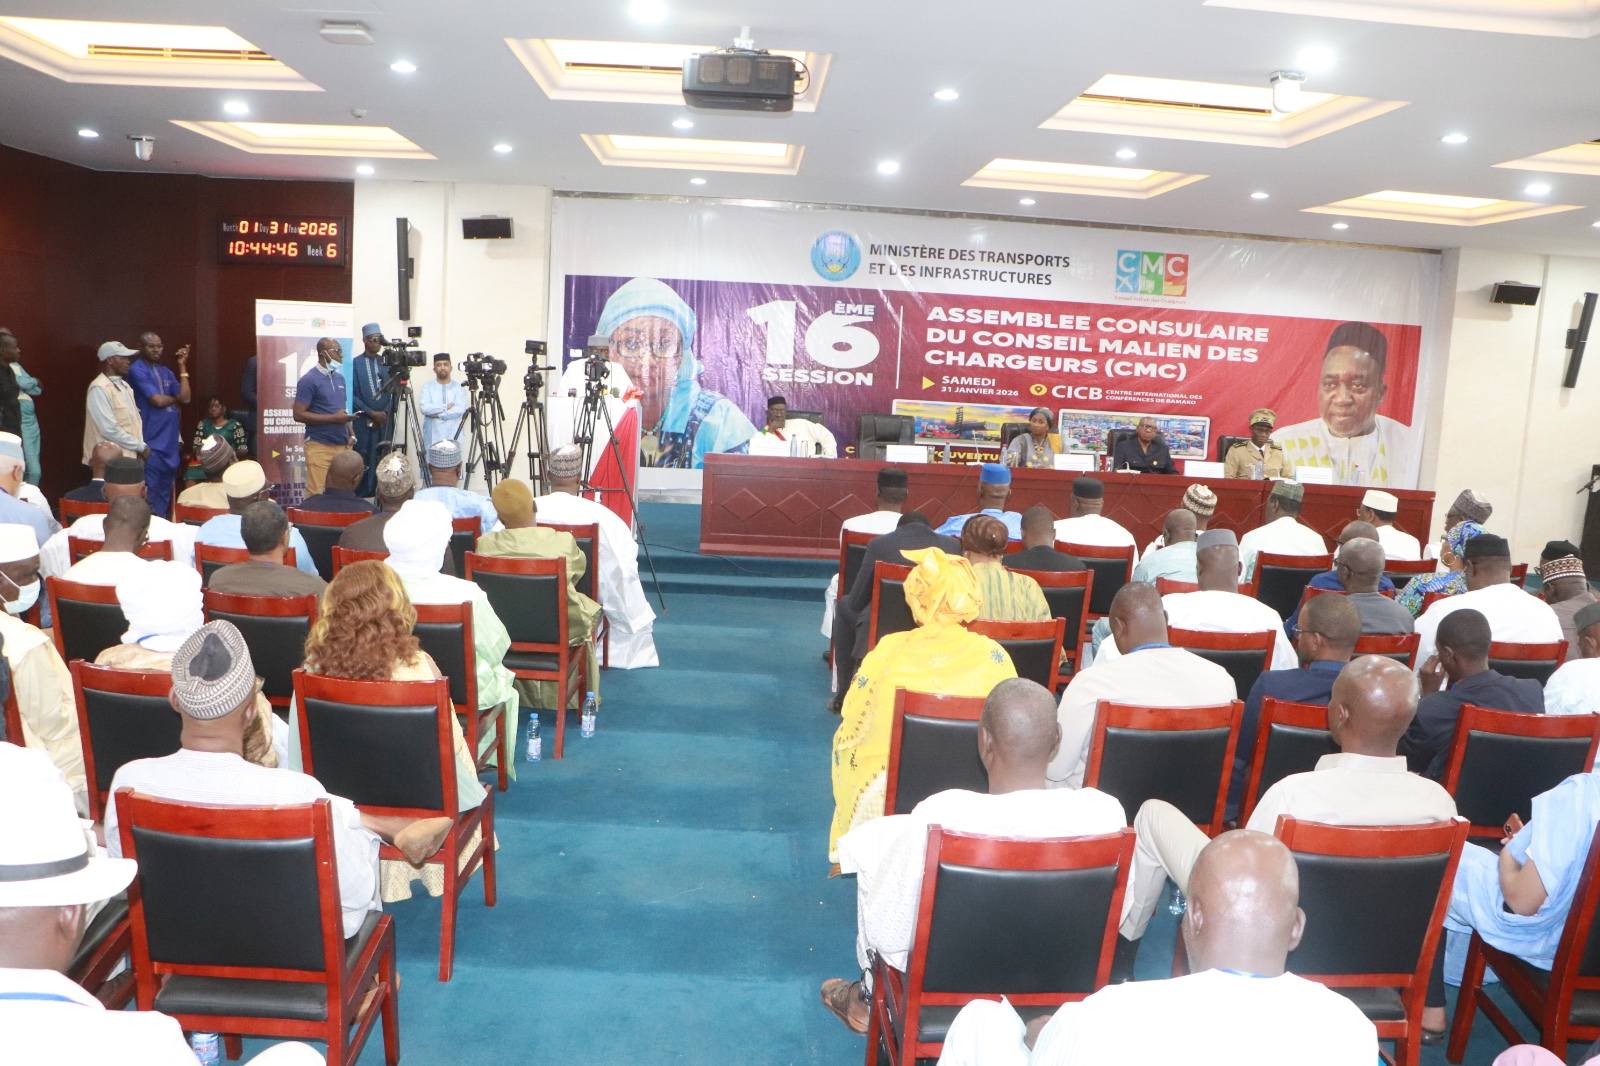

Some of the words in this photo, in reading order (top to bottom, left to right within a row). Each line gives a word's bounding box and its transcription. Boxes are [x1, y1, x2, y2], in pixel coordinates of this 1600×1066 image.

[298, 222, 338, 236] 2026
[229, 241, 298, 257] 10:44:46
[307, 245, 324, 257] Week
[326, 243, 337, 258] 6
[869, 243, 945, 260] MINISTÈRE
[948, 247, 976, 262] DES
[979, 250, 1071, 268] TRANSPORTS
[1118, 252, 1186, 277] CMC
[869, 262, 885, 275] ET
[889, 264, 916, 278] DES
[919, 266, 1053, 286] INFRASTRUCTURES
[834, 300, 875, 316] ÈME
[926, 306, 1091, 331] ASSEMBLEE
[1096, 317, 1270, 343] CONSULAIRE
[746, 300, 881, 369] 16
[926, 327, 966, 344] DU
[972, 330, 1093, 353] CONSEIL
[1098, 338, 1201, 360] MALIEN
[1207, 345, 1259, 363] DES
[924, 349, 1098, 375] CHARGEURS
[1104, 358, 1187, 382] (CMC)
[762, 367, 874, 386] SESSION
[941, 375, 996, 387] SAMEDI
[954, 386, 994, 395] JANVIER
[1051, 385, 1103, 400] CICB
[1133, 390, 1187, 399] INTERNATIONAL
[263, 409, 293, 417] ASSEMB
